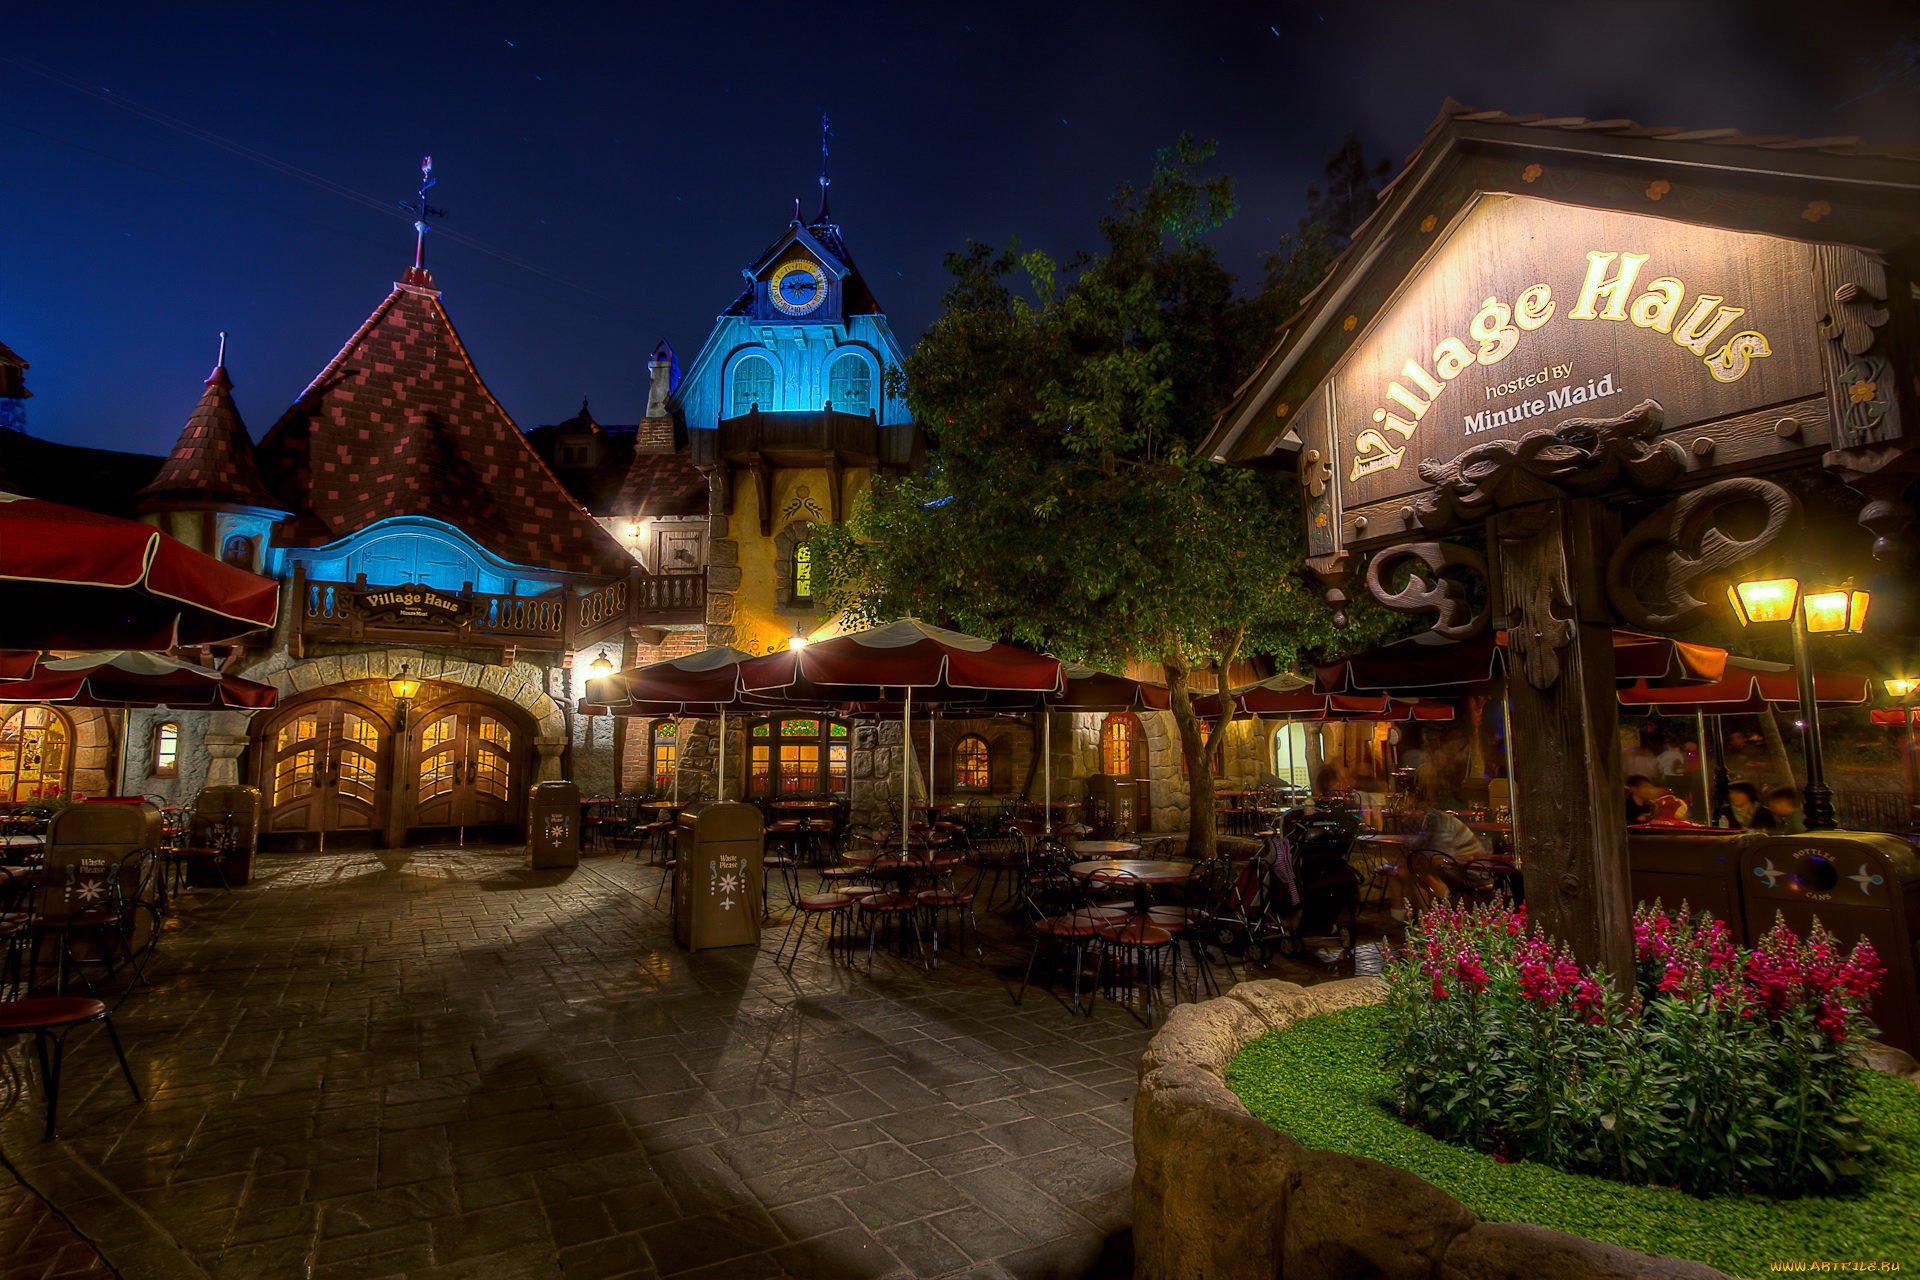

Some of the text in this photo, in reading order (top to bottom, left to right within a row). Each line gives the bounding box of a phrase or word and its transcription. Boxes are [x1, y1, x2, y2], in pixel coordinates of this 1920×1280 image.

[1350, 250, 1773, 482] Village Haus
[1485, 367, 1549, 400] hosted
[1464, 399, 1546, 436] Minute
[366, 592, 459, 612] Village Haus
[81, 858, 106, 866] Waste
[1792, 849, 1836, 862] BOTTLES
[79, 866, 106, 874] Please
[1805, 891, 1832, 900] CANS
